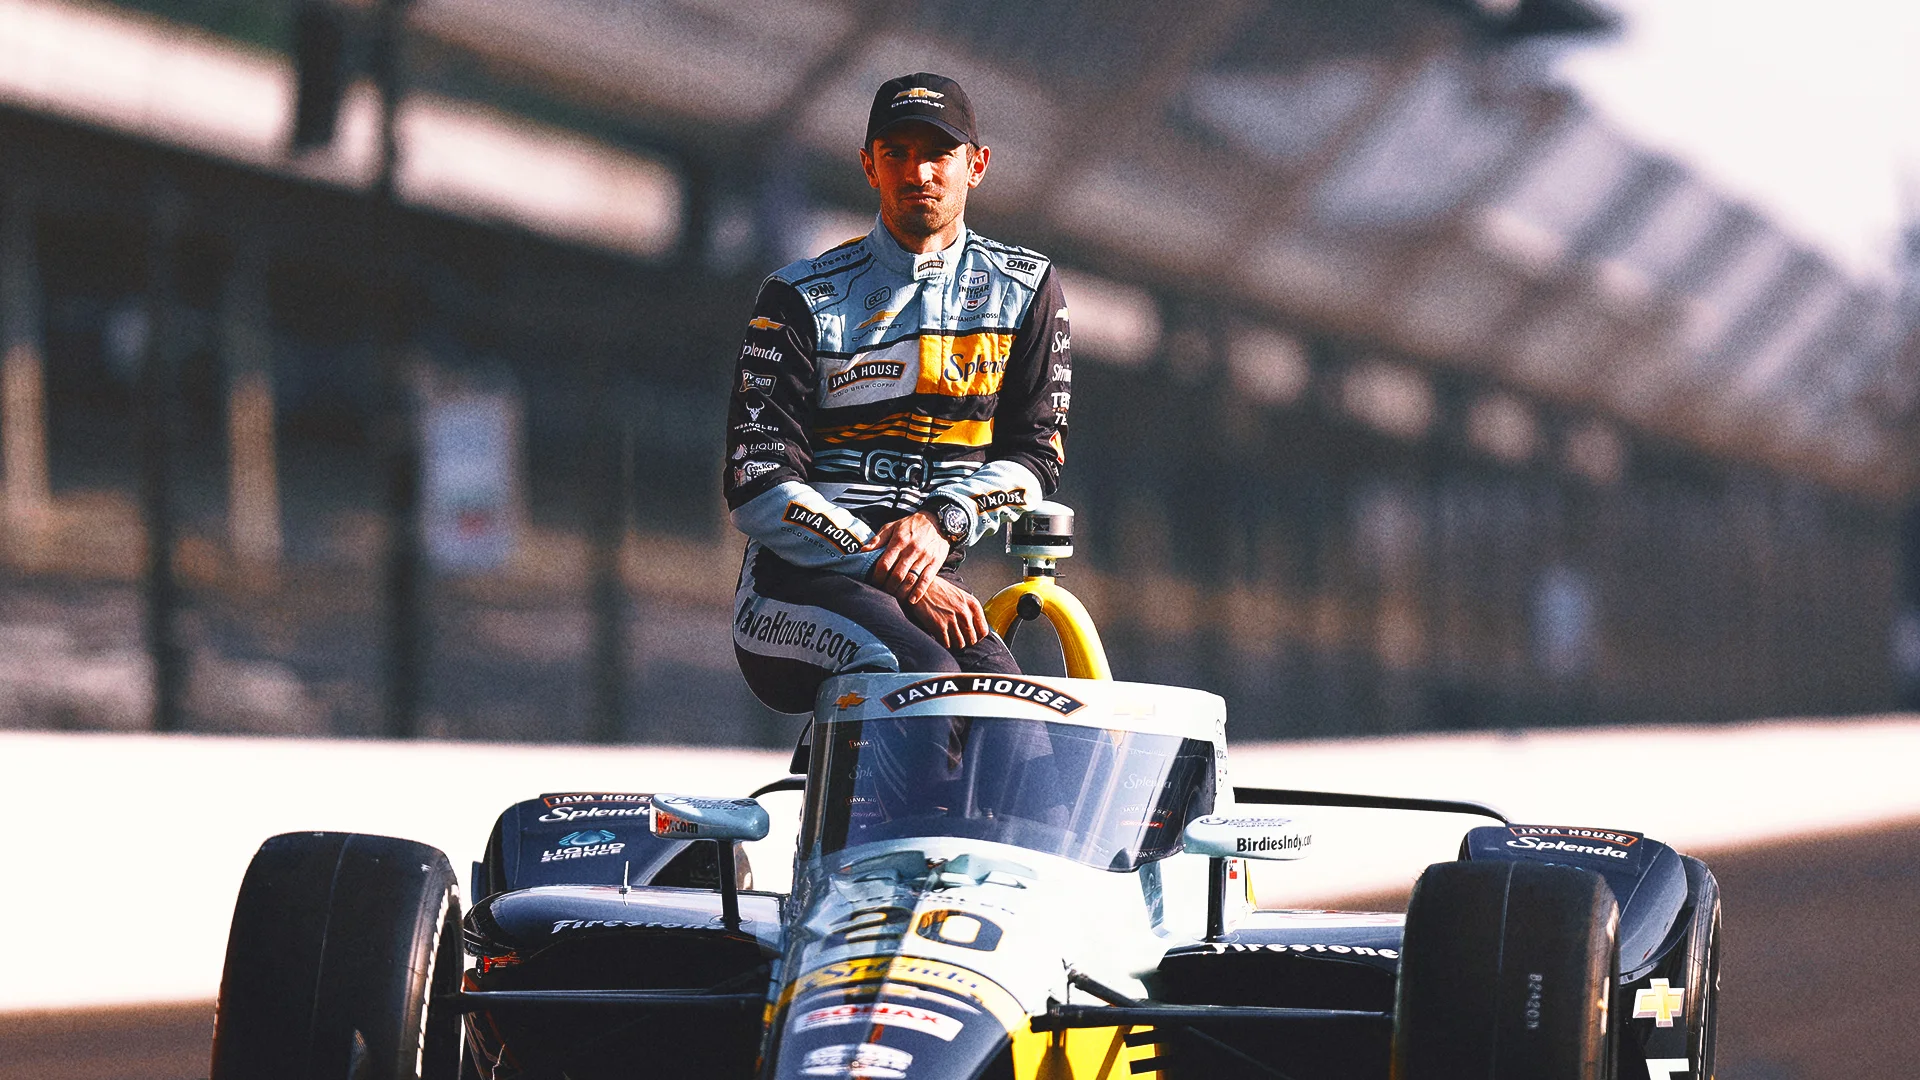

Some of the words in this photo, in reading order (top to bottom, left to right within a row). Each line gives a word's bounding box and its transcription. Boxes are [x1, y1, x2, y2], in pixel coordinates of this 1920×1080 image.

[811, 245, 866, 271] Firestone
[1006, 259, 1037, 272] OMP
[808, 283, 836, 297] OMP
[740, 339, 783, 362] plenda
[832, 369, 858, 388] JAVA
[861, 364, 900, 377] HOUSE
[750, 443, 786, 451] LIQUID
[790, 508, 823, 529] JAVA
[780, 526, 803, 538] COLD
[803, 534, 825, 548] BREW
[897, 680, 959, 705] JAVA
[555, 795, 594, 804] JAVA
[541, 848, 621, 862] SCIENCE
[543, 843, 625, 858] LIQUID
[818, 906, 1004, 952] 20
[1211, 943, 1399, 961] Firestone
[806, 1005, 940, 1024] SONAX
